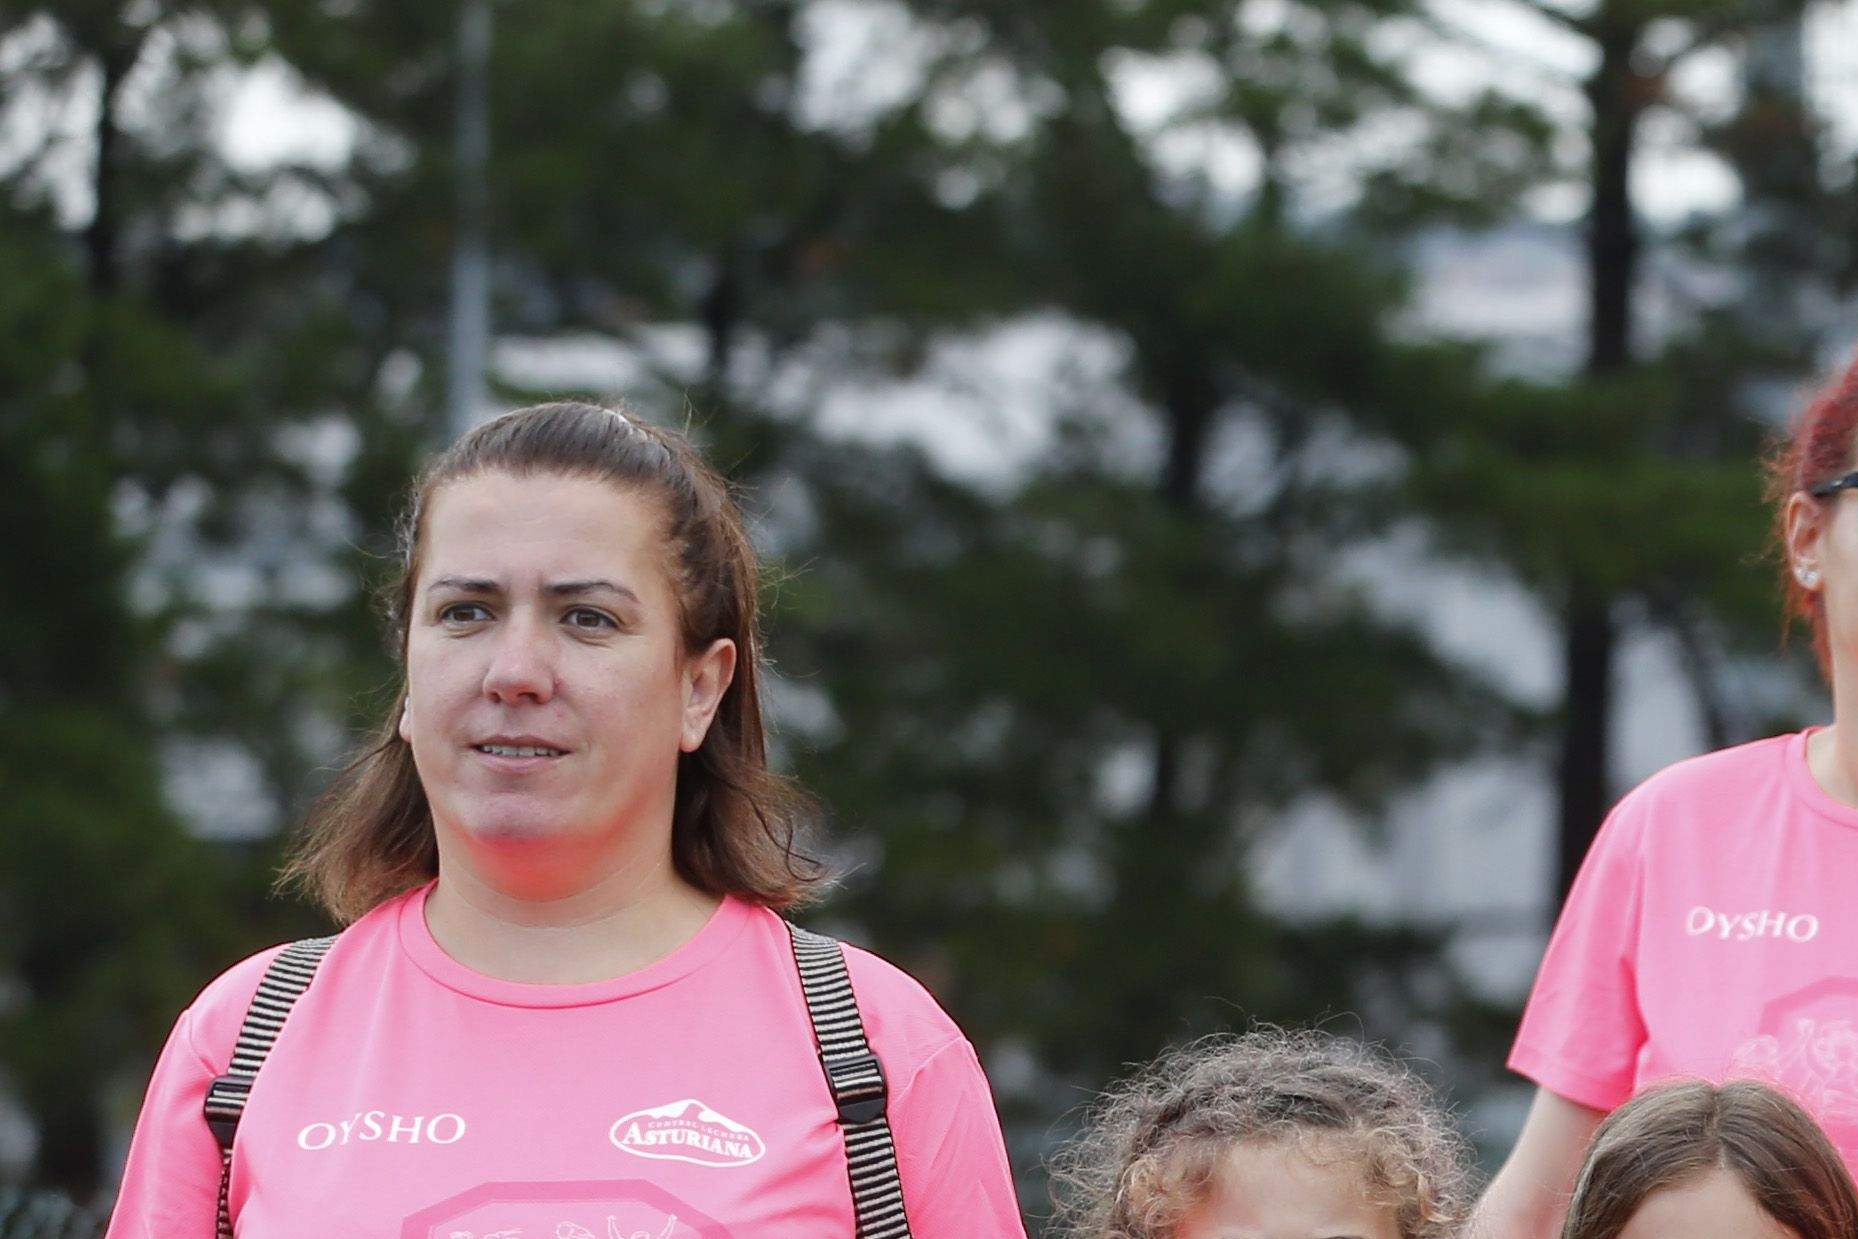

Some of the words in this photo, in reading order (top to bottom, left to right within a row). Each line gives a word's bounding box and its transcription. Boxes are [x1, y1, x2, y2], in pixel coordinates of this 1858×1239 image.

[1686, 906, 1820, 943] OYSHO
[297, 1110, 466, 1150] OYSHO
[622, 1121, 753, 1158] ASTURIANA
